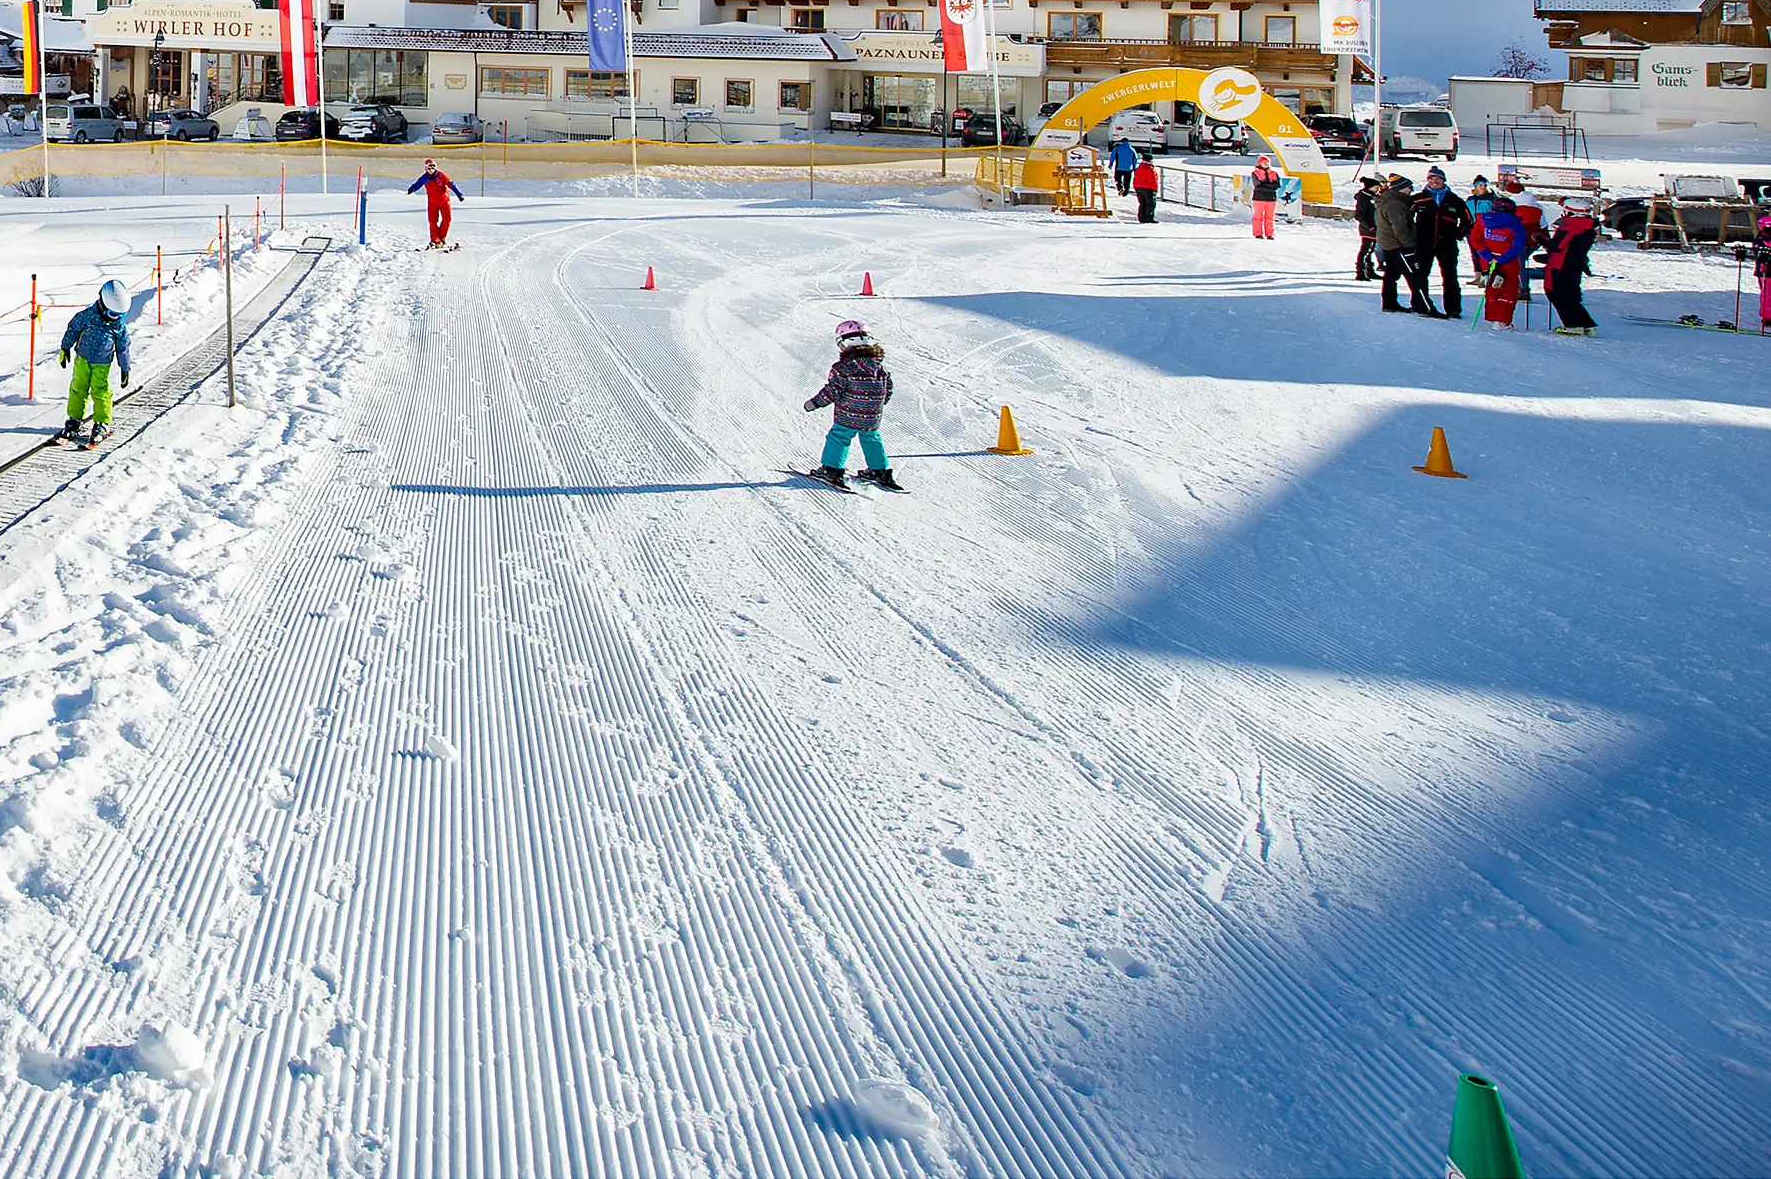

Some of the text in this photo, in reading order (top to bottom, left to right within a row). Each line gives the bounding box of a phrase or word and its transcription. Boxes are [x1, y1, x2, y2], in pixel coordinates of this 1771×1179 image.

[134, 20, 254, 38] WIRLER HOF
[1651, 62, 1698, 74] Gams-
[1657, 76, 1689, 87] blick
[1101, 81, 1176, 104] ZWERGERLWELT
